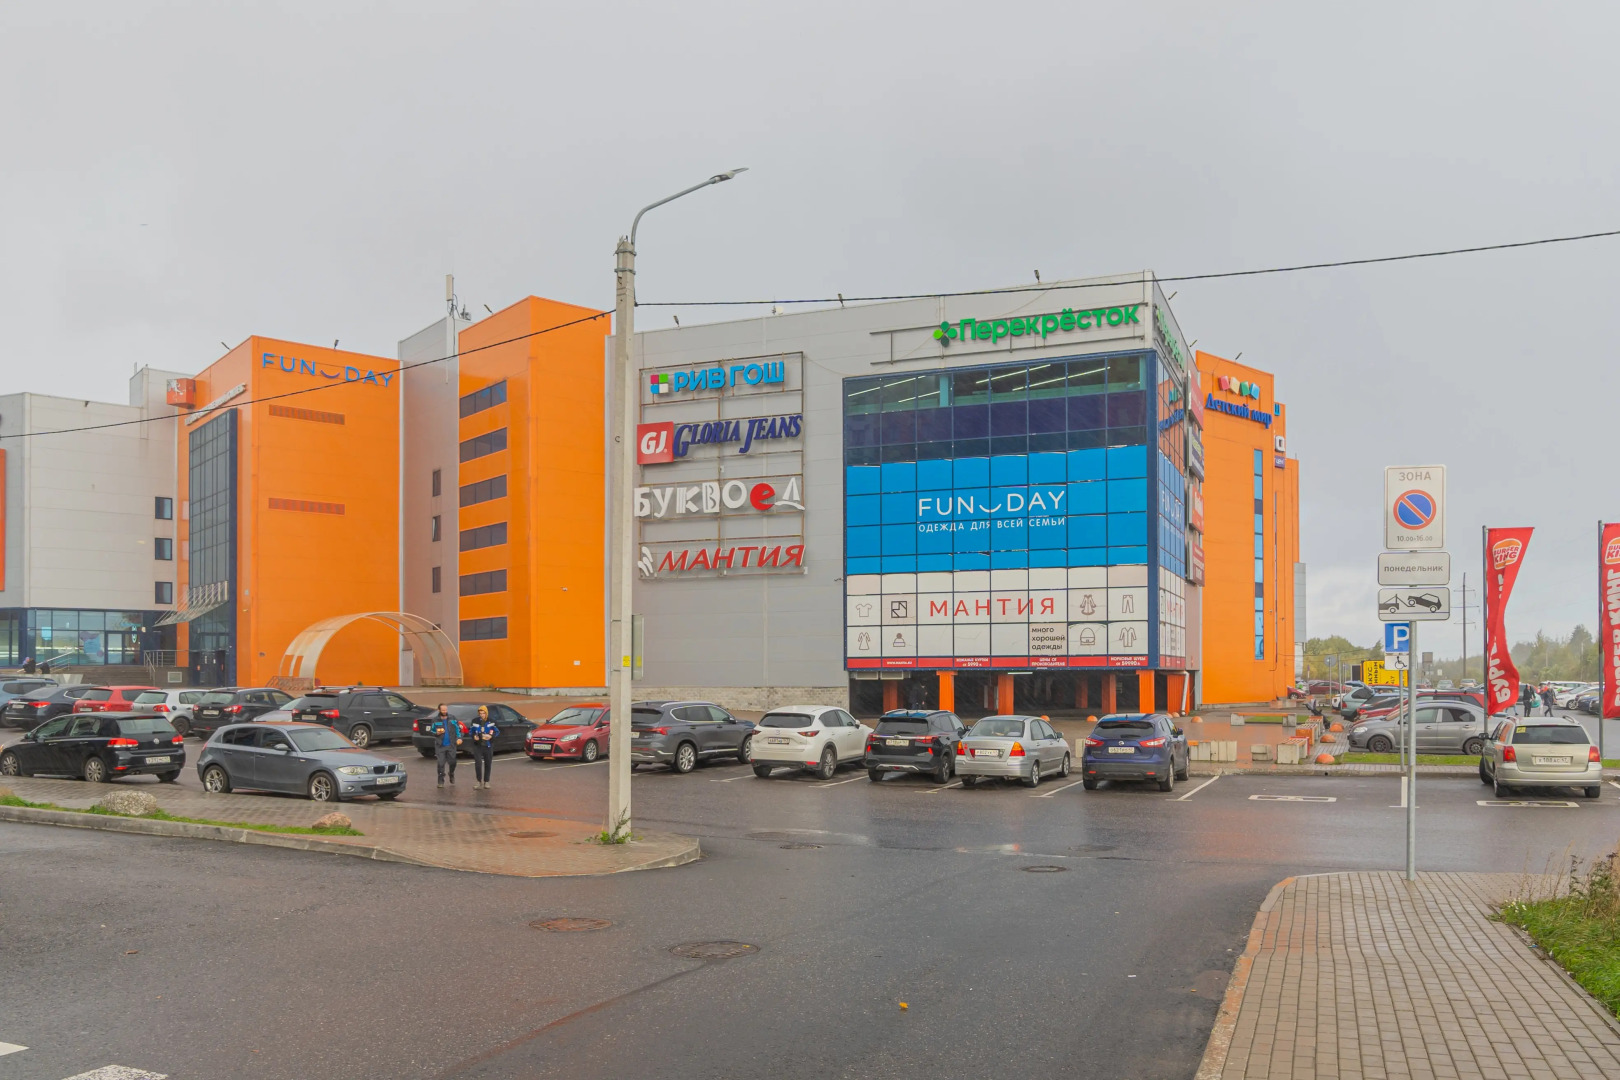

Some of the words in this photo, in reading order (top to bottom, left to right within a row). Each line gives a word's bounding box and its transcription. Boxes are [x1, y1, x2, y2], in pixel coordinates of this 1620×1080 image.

[959, 305, 1140, 344] Перекрёсток
[262, 352, 316, 376] FUN
[345, 366, 393, 387] DAY
[673, 367, 726, 392] РИВ
[729, 361, 785, 388] ГОШ
[1205, 393, 1250, 420] Детский
[1250, 409, 1273, 429] мир
[640, 430, 668, 455] GJ
[1399, 471, 1432, 481] ЗОНА
[918, 495, 974, 517] FUN
[1007, 490, 1065, 512] DAY
[918, 522, 965, 533] ОДЕЖДА
[970, 521, 991, 531] ДЛЯ
[997, 517, 1024, 529] ВСЕЙ
[1028, 517, 1065, 527] СЕМЬИ
[658, 545, 806, 573] МАНТИЯ
[1494, 551, 1517, 564] KING
[929, 597, 1055, 617] МАНТИЯ
[1031, 634, 1066, 642] хорошей
